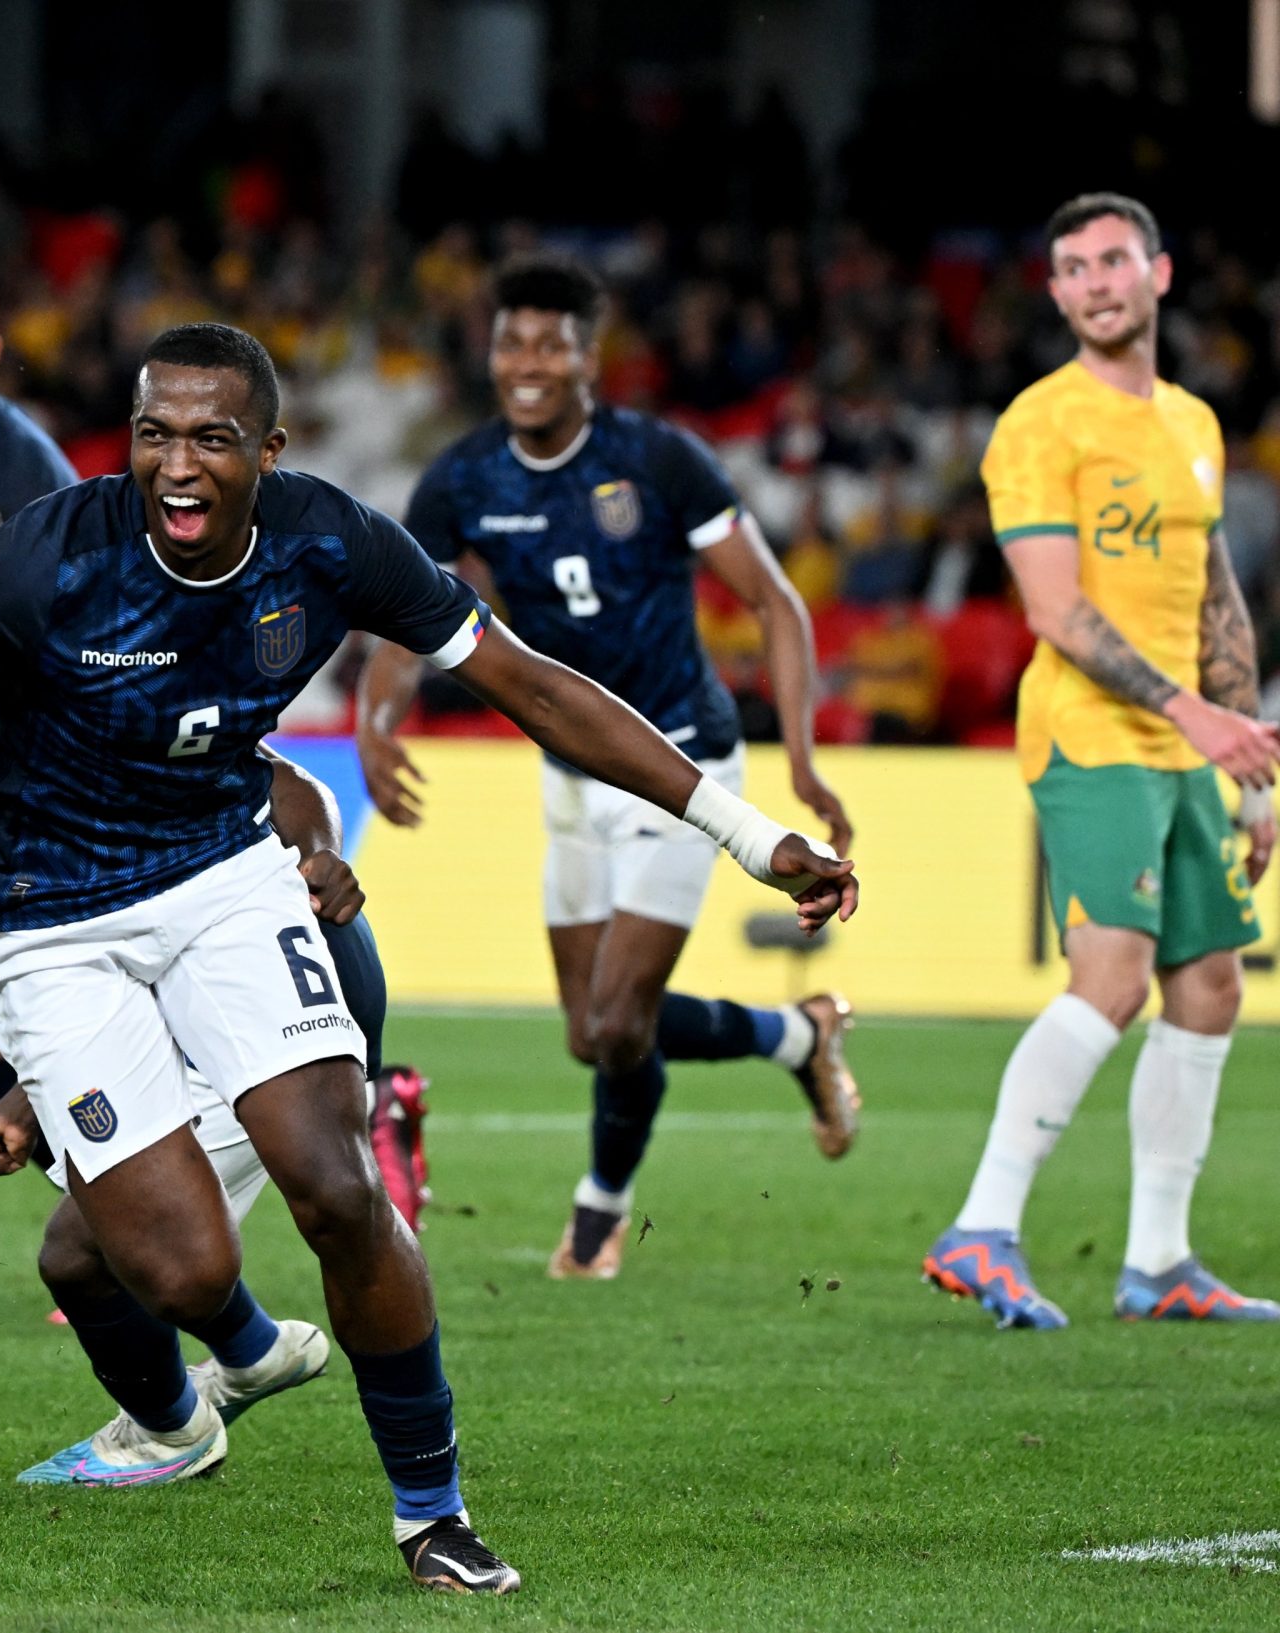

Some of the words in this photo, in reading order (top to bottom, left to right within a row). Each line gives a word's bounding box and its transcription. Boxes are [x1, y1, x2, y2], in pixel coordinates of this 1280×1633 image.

[1095, 502, 1161, 560] 24
[81, 649, 178, 667] marathon
[168, 705, 220, 758] 6
[276, 925, 338, 1008] 6
[282, 1012, 354, 1039] marathon
